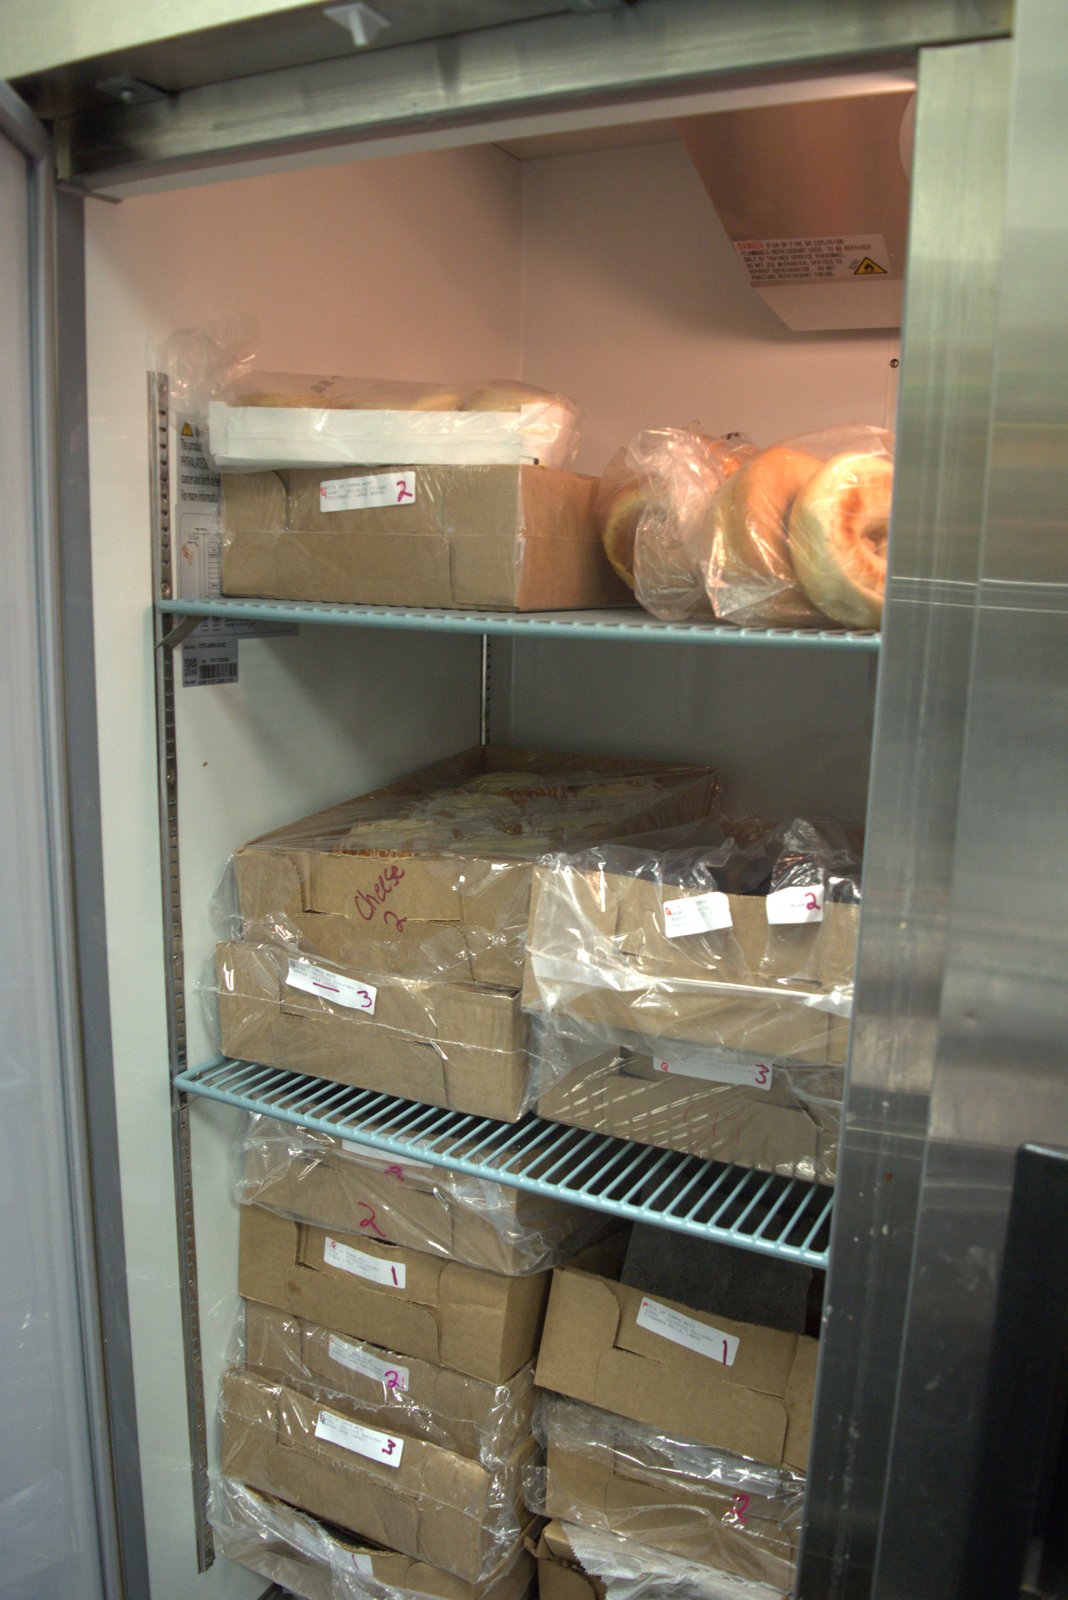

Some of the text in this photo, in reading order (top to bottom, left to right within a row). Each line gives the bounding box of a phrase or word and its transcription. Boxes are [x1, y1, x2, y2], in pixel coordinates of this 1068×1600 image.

[396, 480, 413, 502] 2
[354, 865, 405, 921] Cheese
[804, 891, 821, 910] 2
[383, 911, 408, 933] 2
[356, 990, 373, 1008] 3
[754, 1063, 770, 1085] 3
[357, 1200, 387, 1238] 2
[390, 1265, 398, 1286] 1
[722, 1339, 728, 1366] 1
[384, 1370, 404, 1389] 2
[381, 1438, 397, 1456] 3
[730, 1493, 750, 1523] 2
